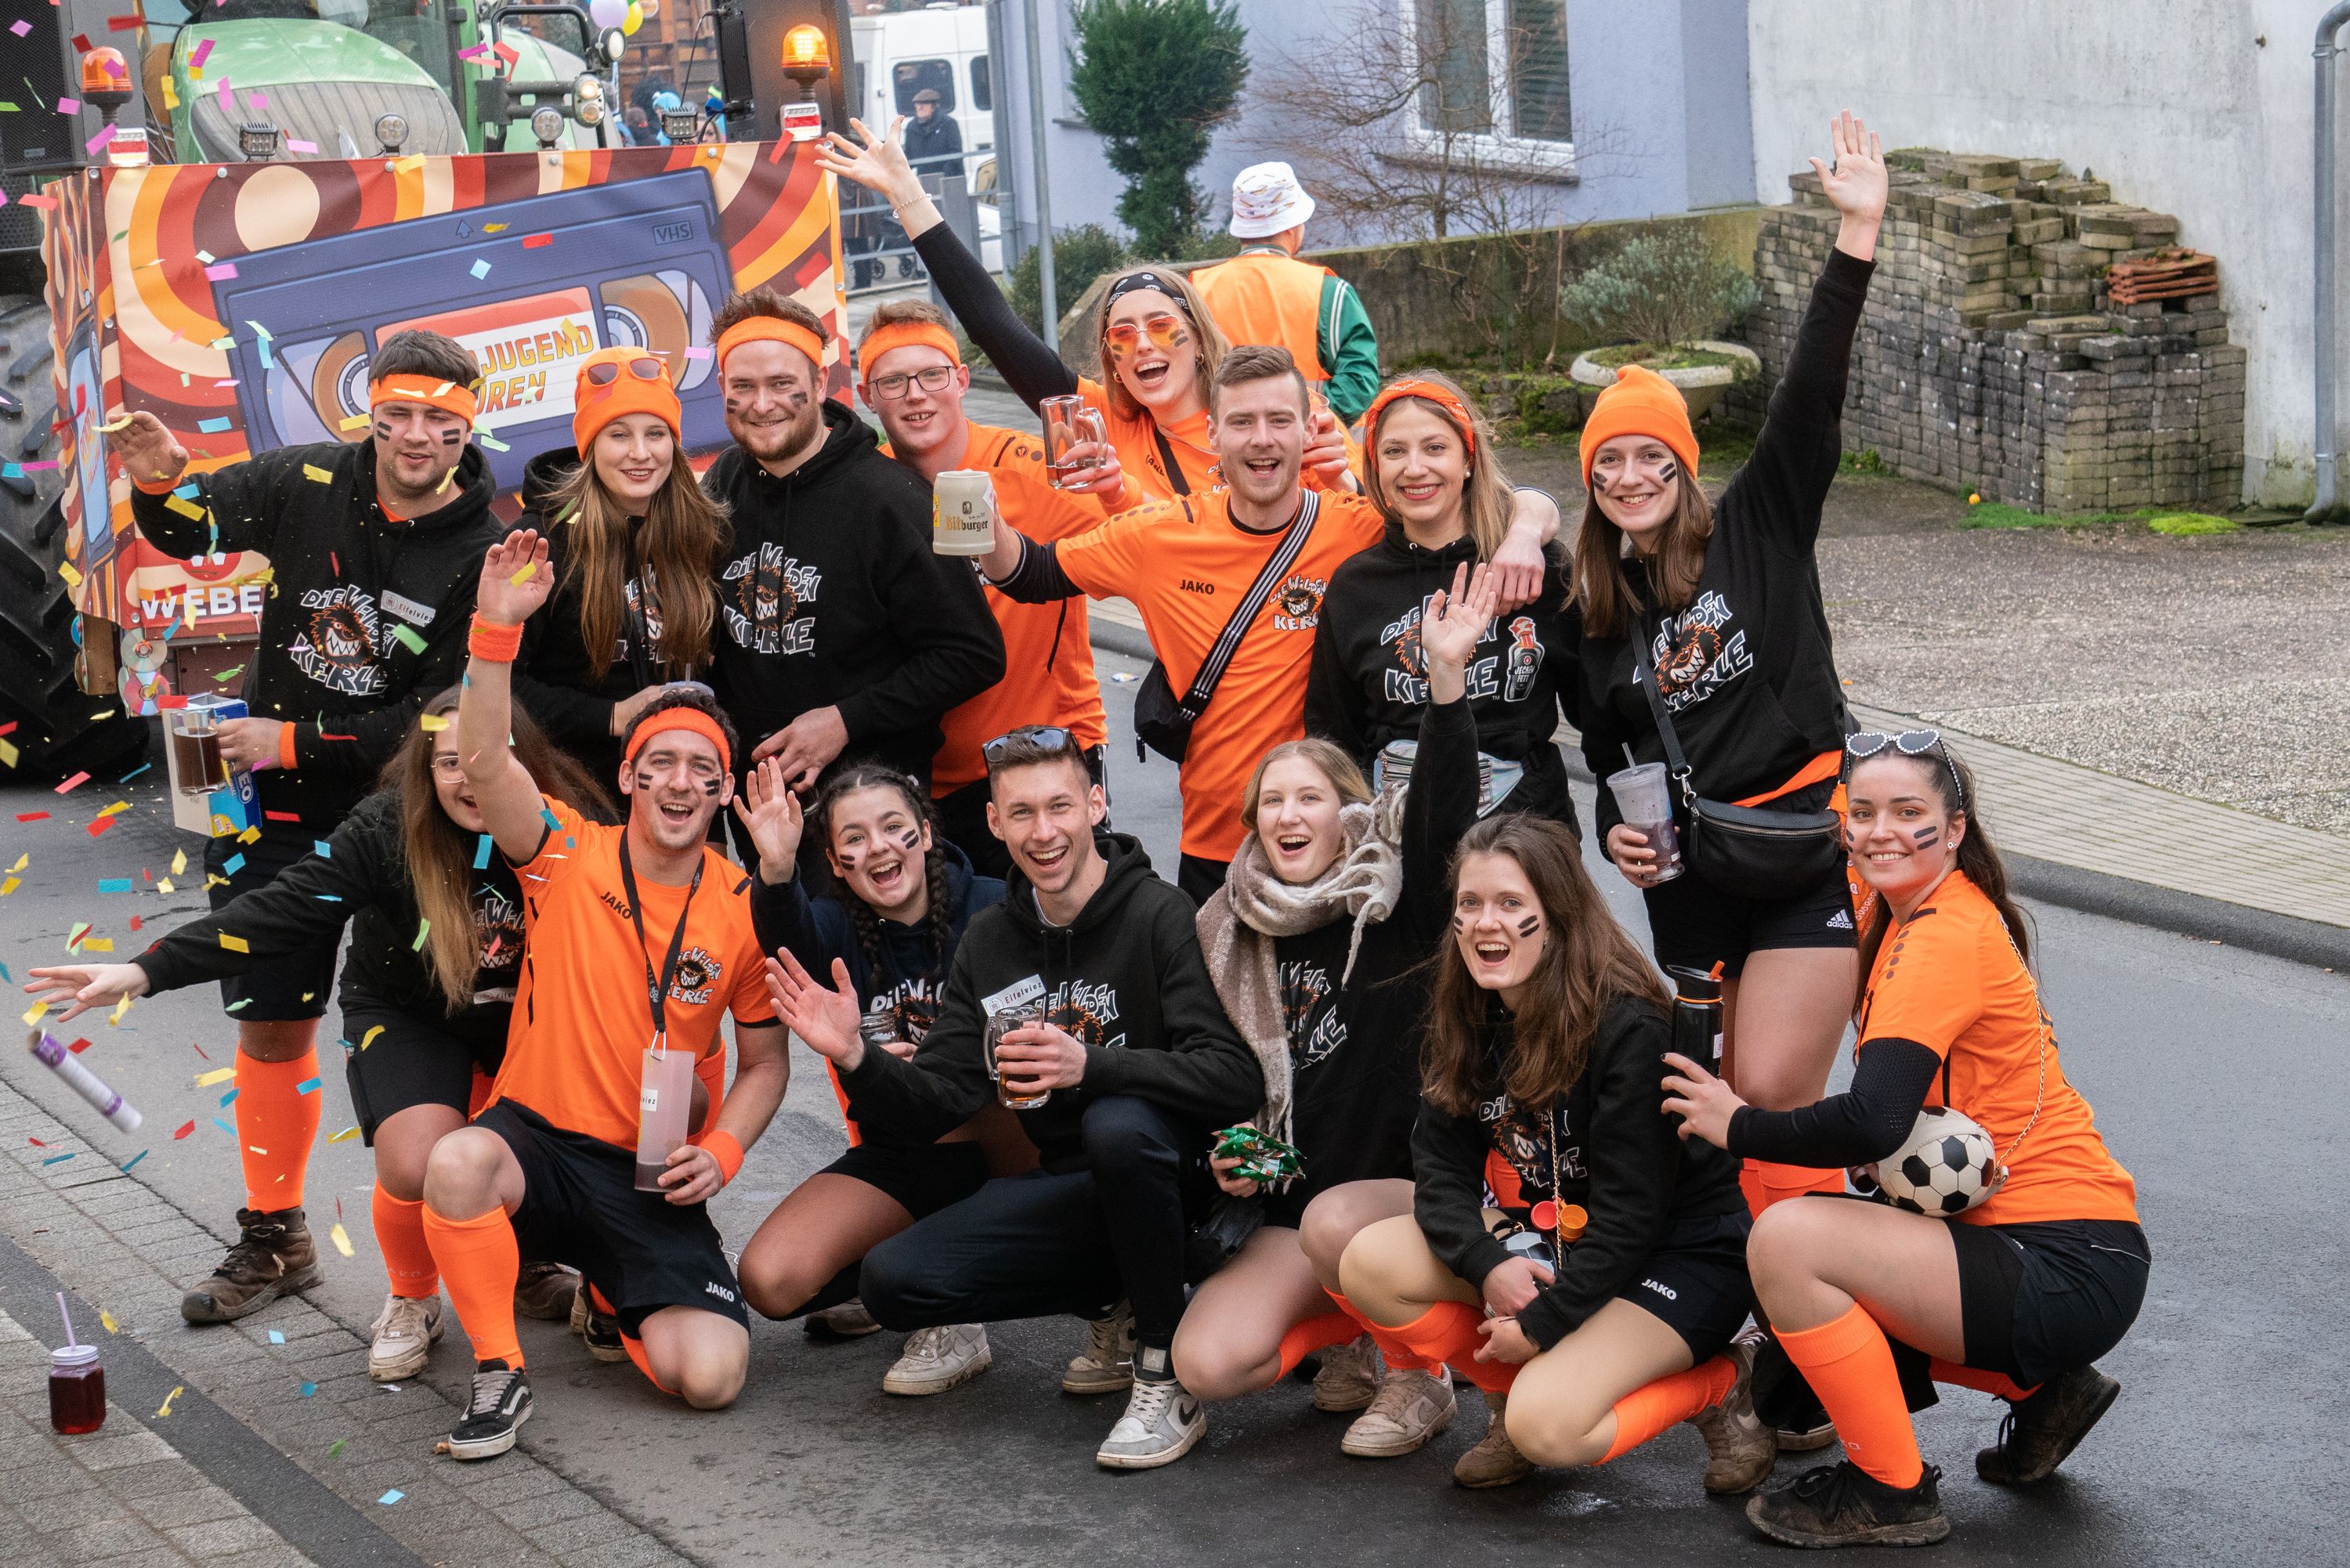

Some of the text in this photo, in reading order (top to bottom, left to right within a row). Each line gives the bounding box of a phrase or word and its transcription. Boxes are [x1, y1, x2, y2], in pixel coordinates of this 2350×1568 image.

[656, 223, 689, 241] VHS
[468, 323, 594, 377] JUGEND
[945, 515, 989, 532] Bitburger
[1180, 579, 1215, 595] JAKO
[1269, 574, 1328, 605] DiE WiLDEN
[301, 589, 347, 609] DiE
[723, 605, 816, 655] KERLE
[1273, 609, 1321, 631] KERL
[291, 632, 390, 695] KERLE
[1384, 656, 1499, 705] KELE
[600, 891, 633, 919] JAKO
[1826, 920, 1853, 930] adidas
[678, 950, 692, 962] iE
[1005, 981, 1043, 1005] Eifelviez
[706, 1281, 735, 1302] JAKO
[1641, 1278, 1676, 1300] JAKO
